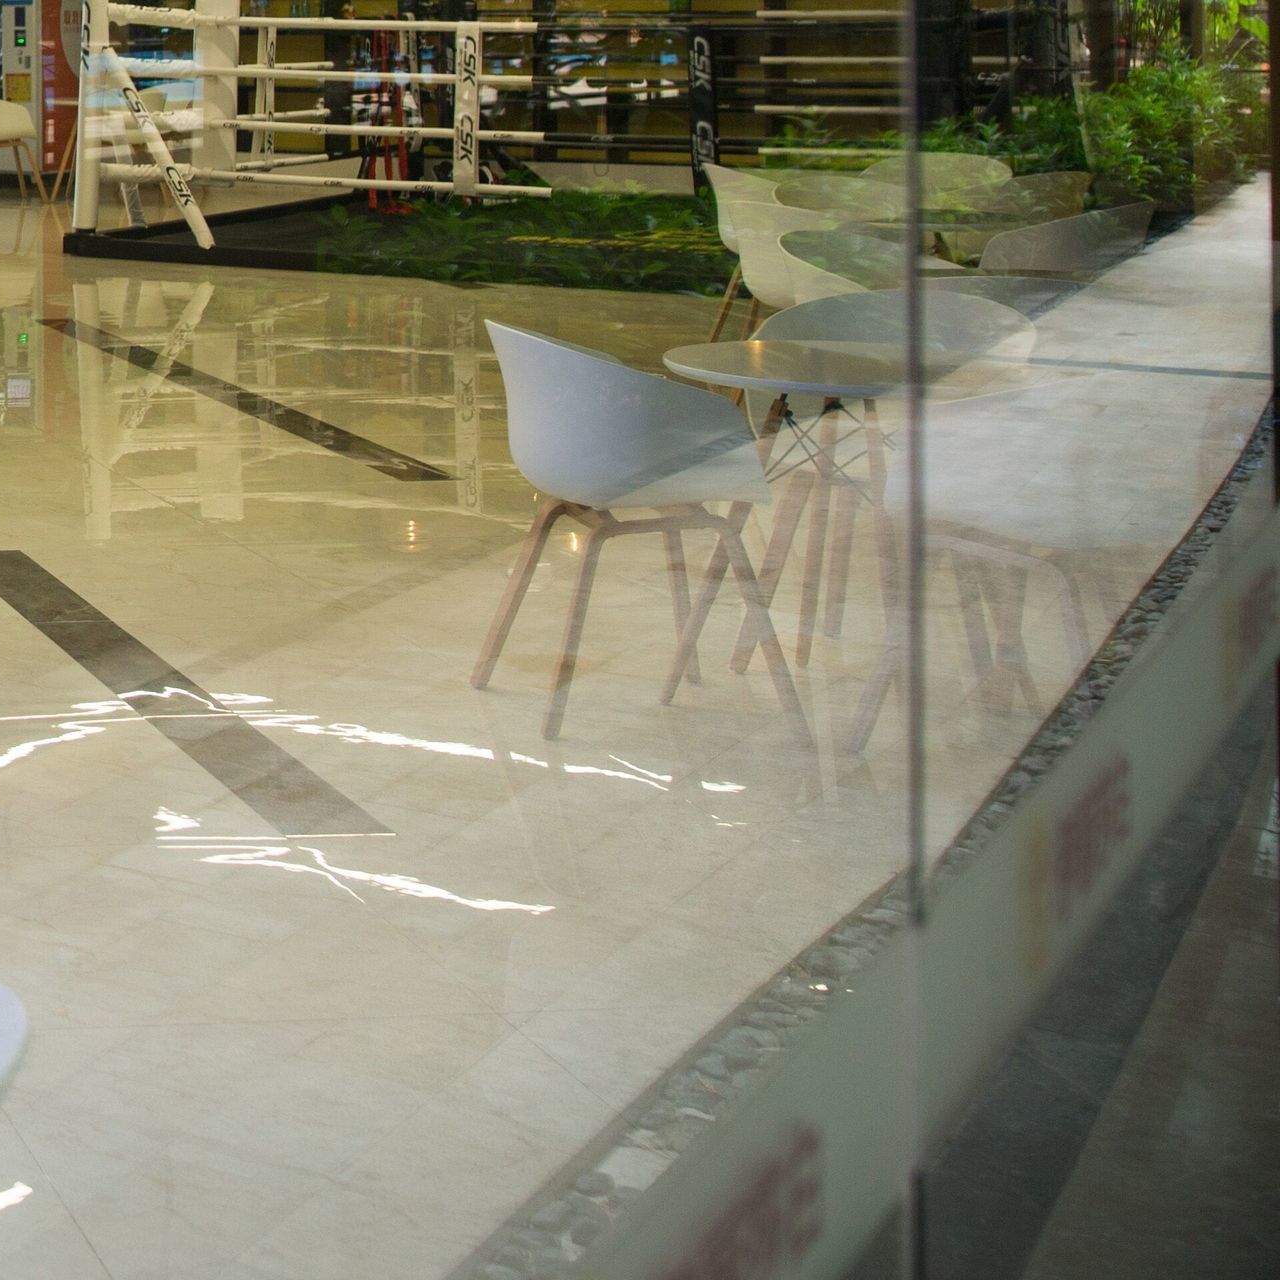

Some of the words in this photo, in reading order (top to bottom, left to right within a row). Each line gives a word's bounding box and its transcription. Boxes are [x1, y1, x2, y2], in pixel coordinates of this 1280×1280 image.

[463, 35, 476, 87] CSK
[694, 36, 712, 91] CSK
[123, 87, 154, 129] CSK
[460, 113, 474, 166] CSK
[696, 120, 715, 164] CS
[166, 166, 195, 206] CSK
